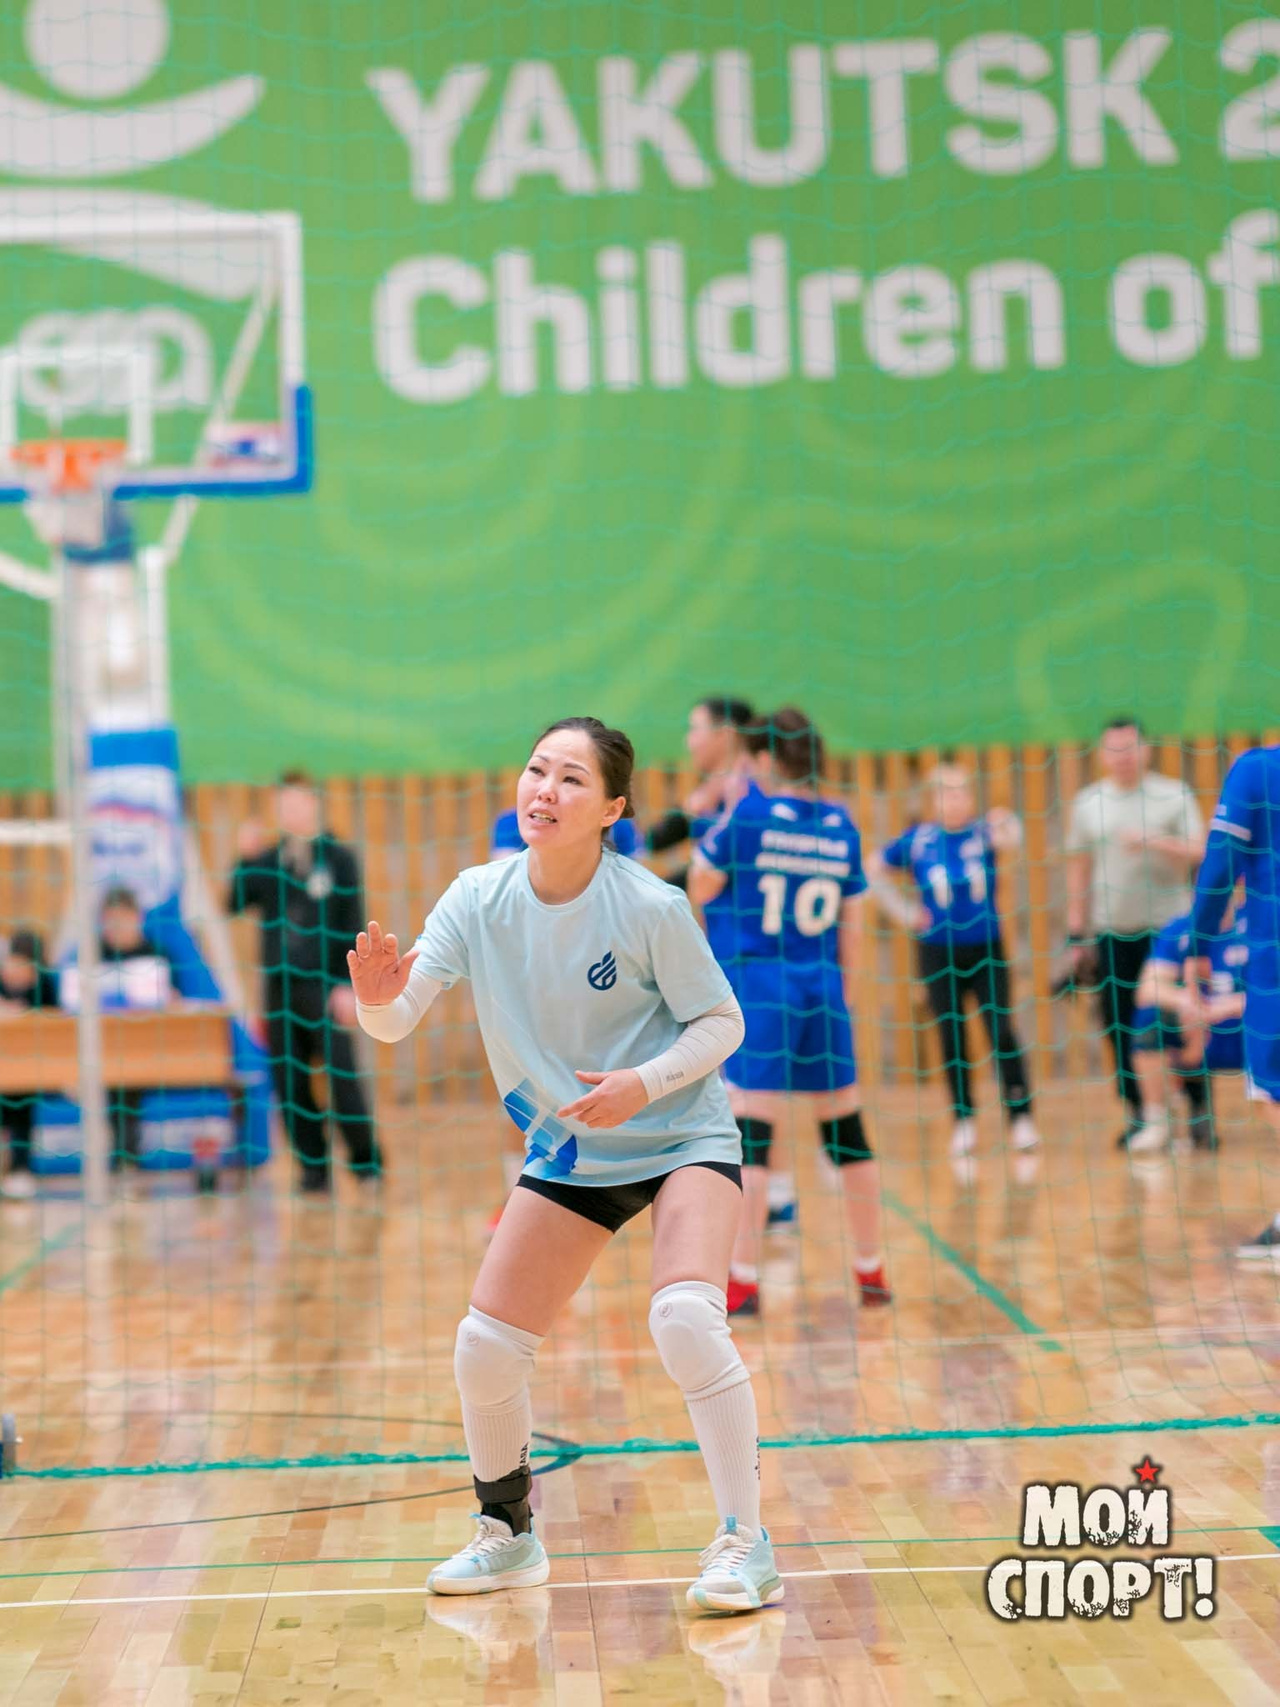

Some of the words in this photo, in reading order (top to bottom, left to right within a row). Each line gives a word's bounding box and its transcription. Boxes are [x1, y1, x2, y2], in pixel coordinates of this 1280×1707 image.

[365, 28, 1179, 203] YAKUTSK
[372, 233, 1066, 403] Children
[1107, 208, 1280, 367] of
[758, 873, 841, 937] 10
